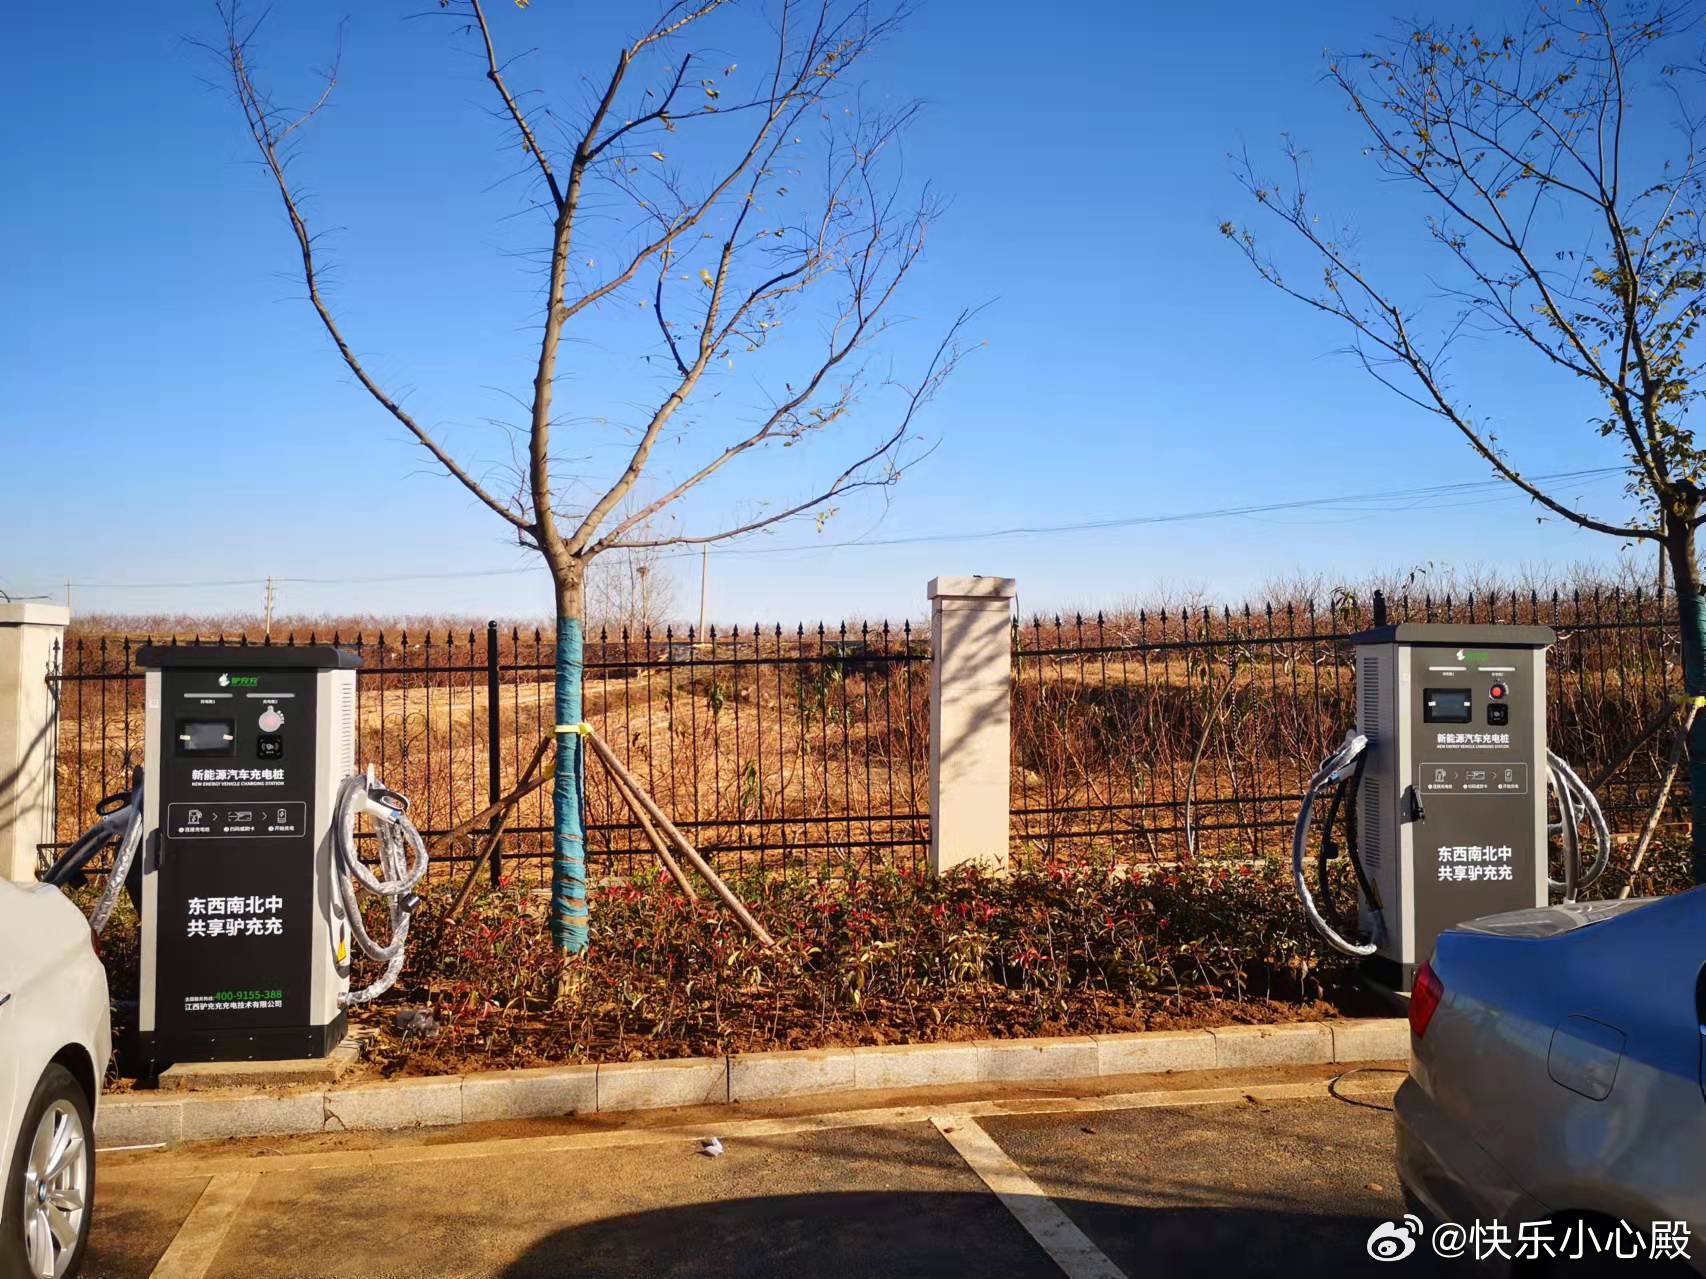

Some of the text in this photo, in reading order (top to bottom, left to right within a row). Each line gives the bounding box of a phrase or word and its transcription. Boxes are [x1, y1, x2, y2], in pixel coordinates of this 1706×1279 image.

[1437, 733, 1509, 744] 新能源汽车充电桩
[192, 769, 285, 781] 新能源汽车充电桩
[1438, 845, 1512, 862] 东西南北中
[1438, 864, 1513, 882] 共享驴充充
[188, 895, 283, 915] 东西南北中
[187, 917, 283, 937] 共享驴充充
[215, 990, 283, 1001] 400-9155-388
[184, 1000, 283, 1011] 江西驴充充充电技术有限公司
